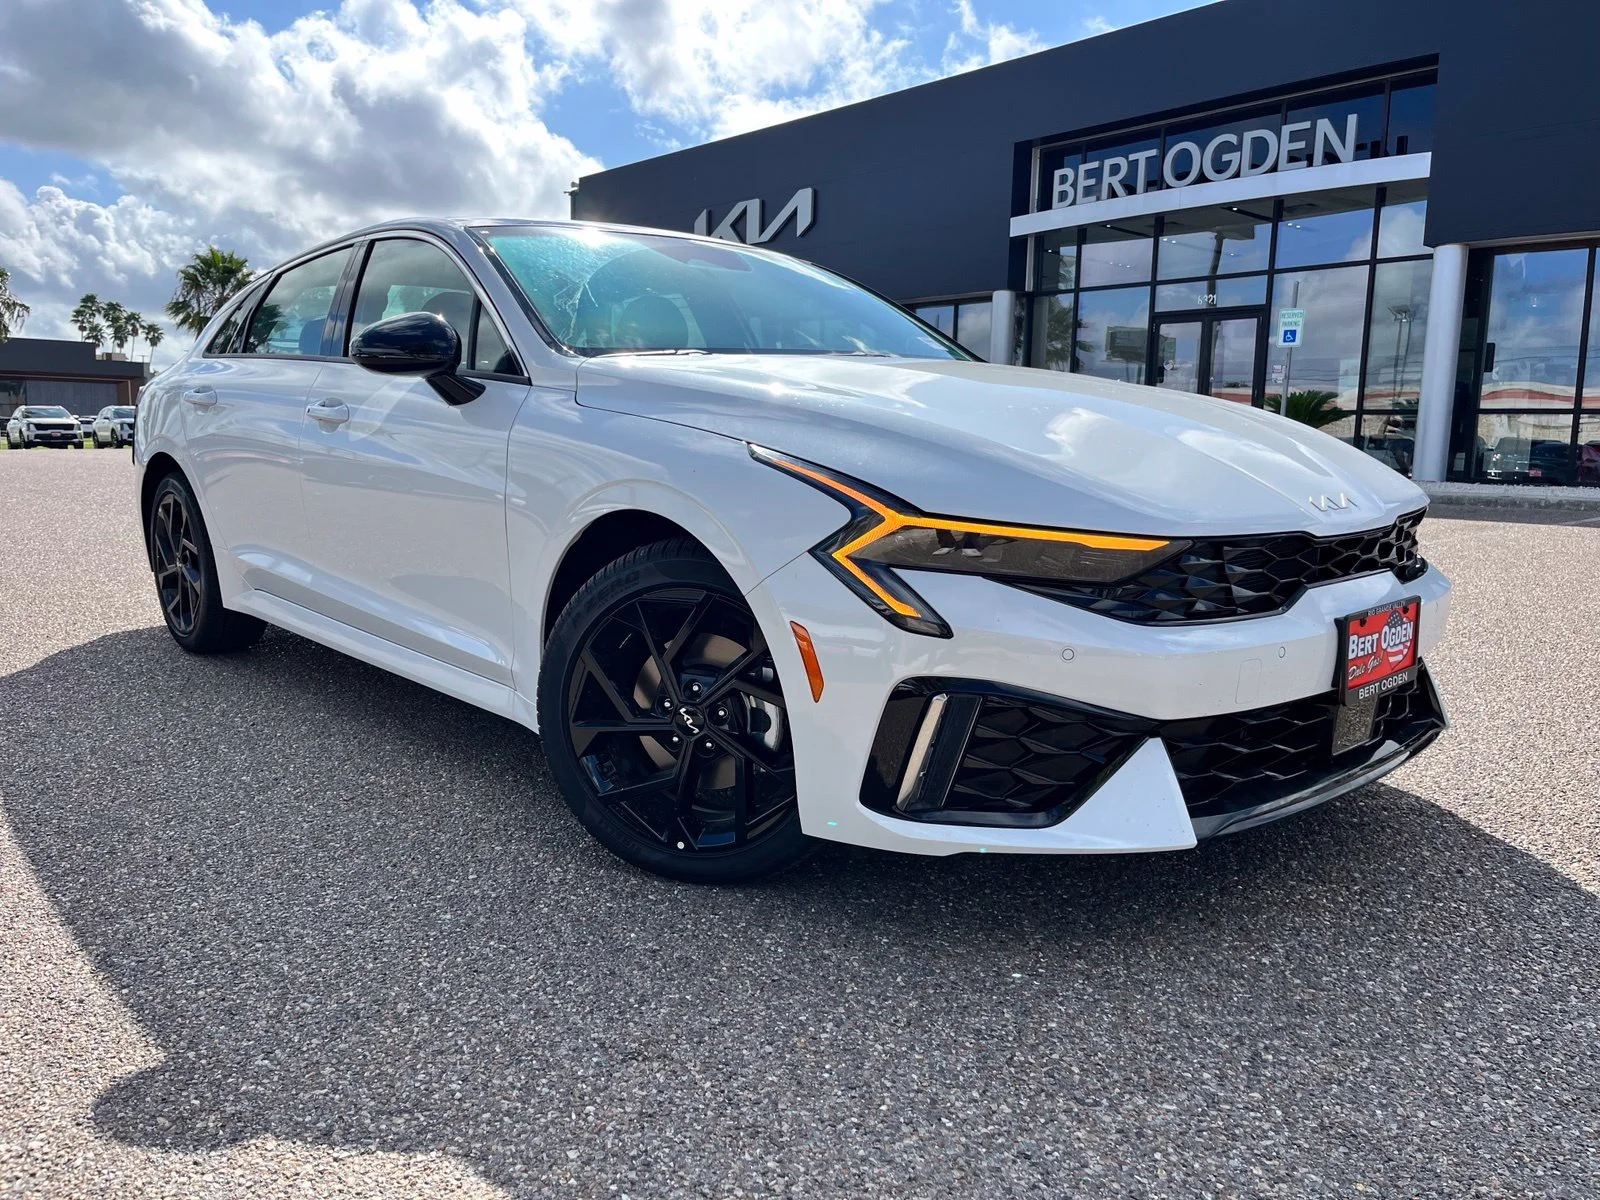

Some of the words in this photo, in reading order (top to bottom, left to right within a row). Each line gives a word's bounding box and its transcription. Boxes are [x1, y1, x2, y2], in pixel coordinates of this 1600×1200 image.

[1051, 148, 1160, 210] BERT
[1162, 113, 1359, 189] OGDEN
[1348, 632, 1380, 660] BERT
[1381, 621, 1414, 650] OGDEN
[1348, 664, 1366, 680] Dale
[1359, 682, 1380, 700] BERT
[1381, 671, 1409, 691] OGDEN
